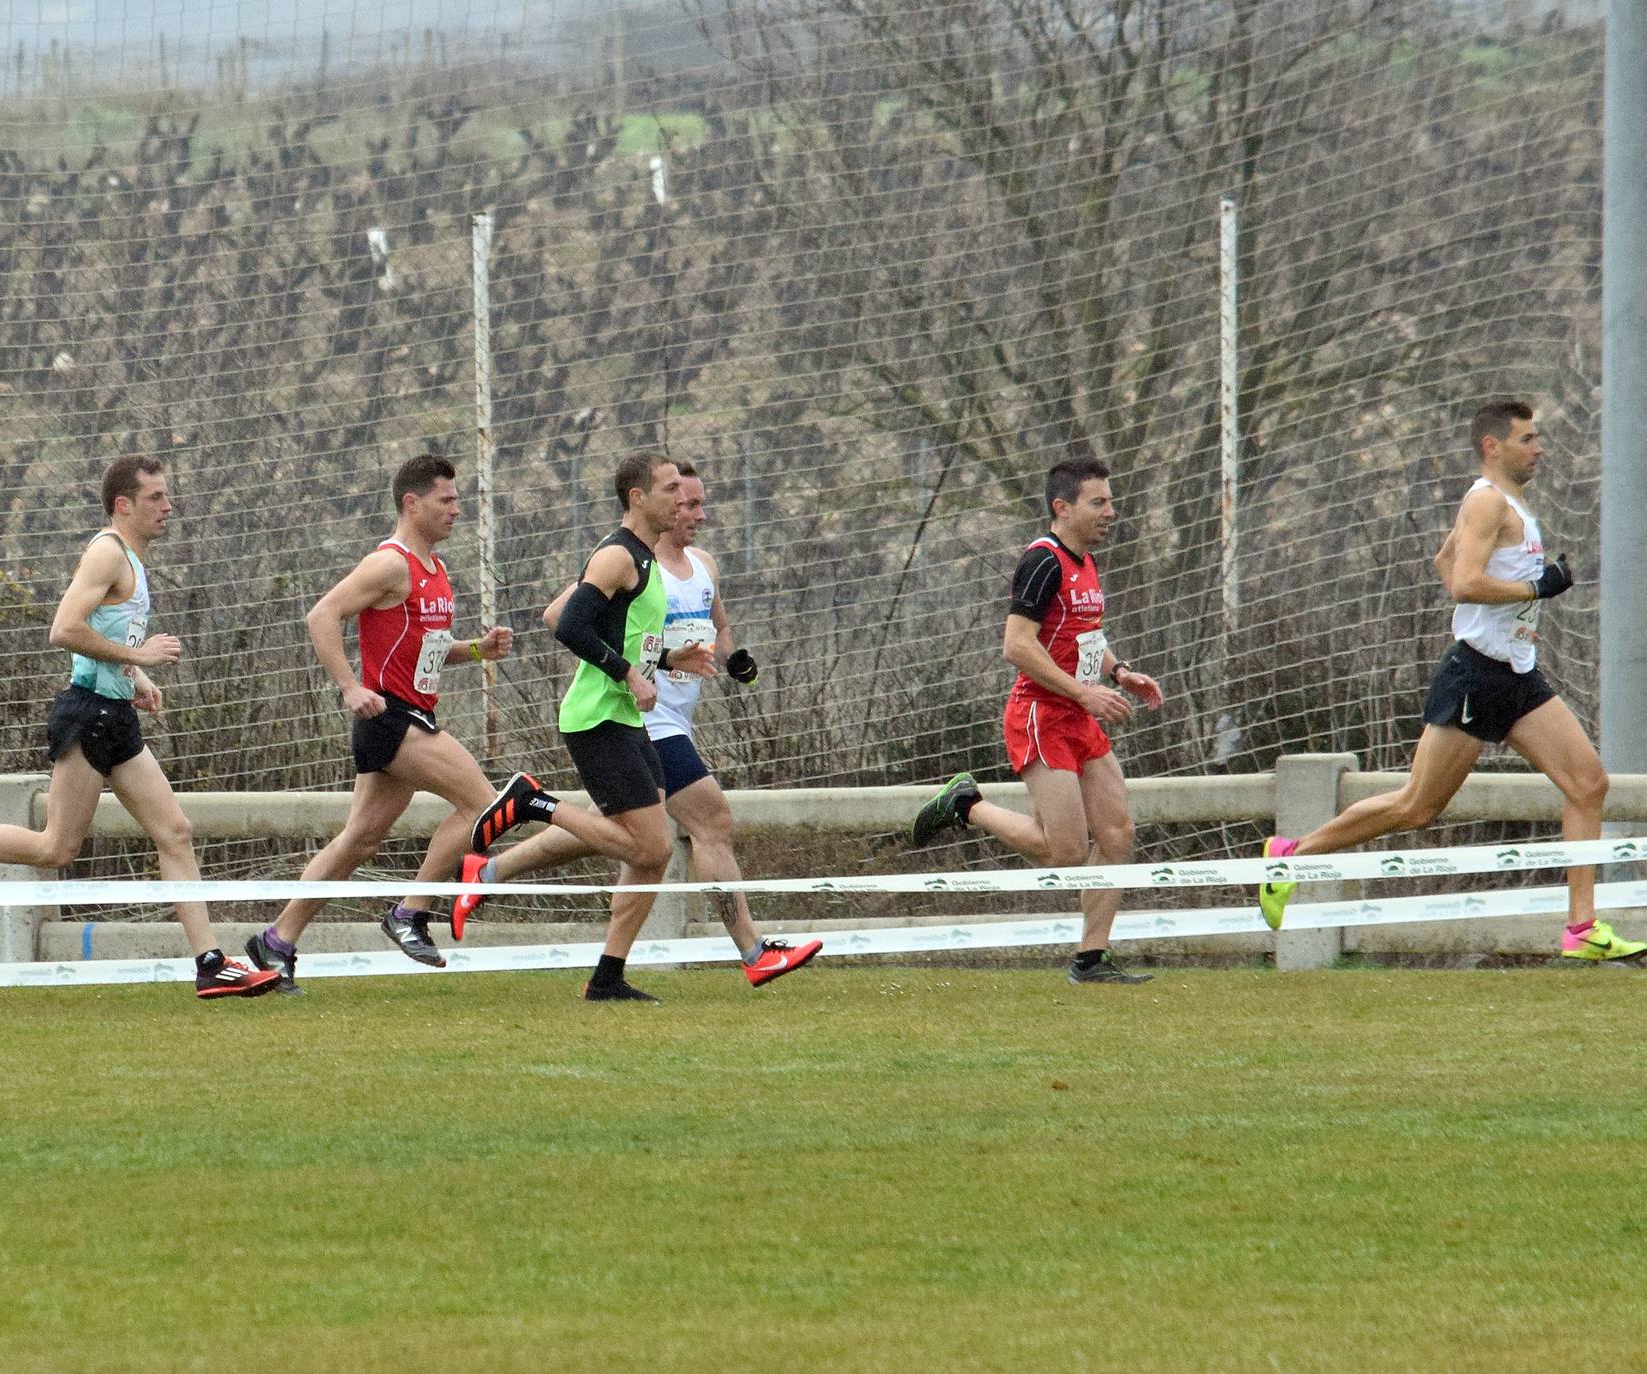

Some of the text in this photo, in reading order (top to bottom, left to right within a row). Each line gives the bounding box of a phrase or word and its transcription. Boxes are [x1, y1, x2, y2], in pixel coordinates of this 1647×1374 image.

[1070, 588, 1089, 605] La
[419, 597, 436, 613] La
[1525, 850, 1564, 858] Gobierno
[1409, 857, 1449, 865] Gobierno
[1294, 863, 1333, 871] Gobierno
[1435, 864, 1457, 874] Rioja
[1064, 873, 1105, 881] Gobierno
[1178, 869, 1218, 877] Gobierno
[1308, 871, 1319, 879] La
[1320, 870, 1342, 880] Rioja
[1092, 880, 1114, 888] Rioja
[1206, 875, 1228, 885] Rioja
